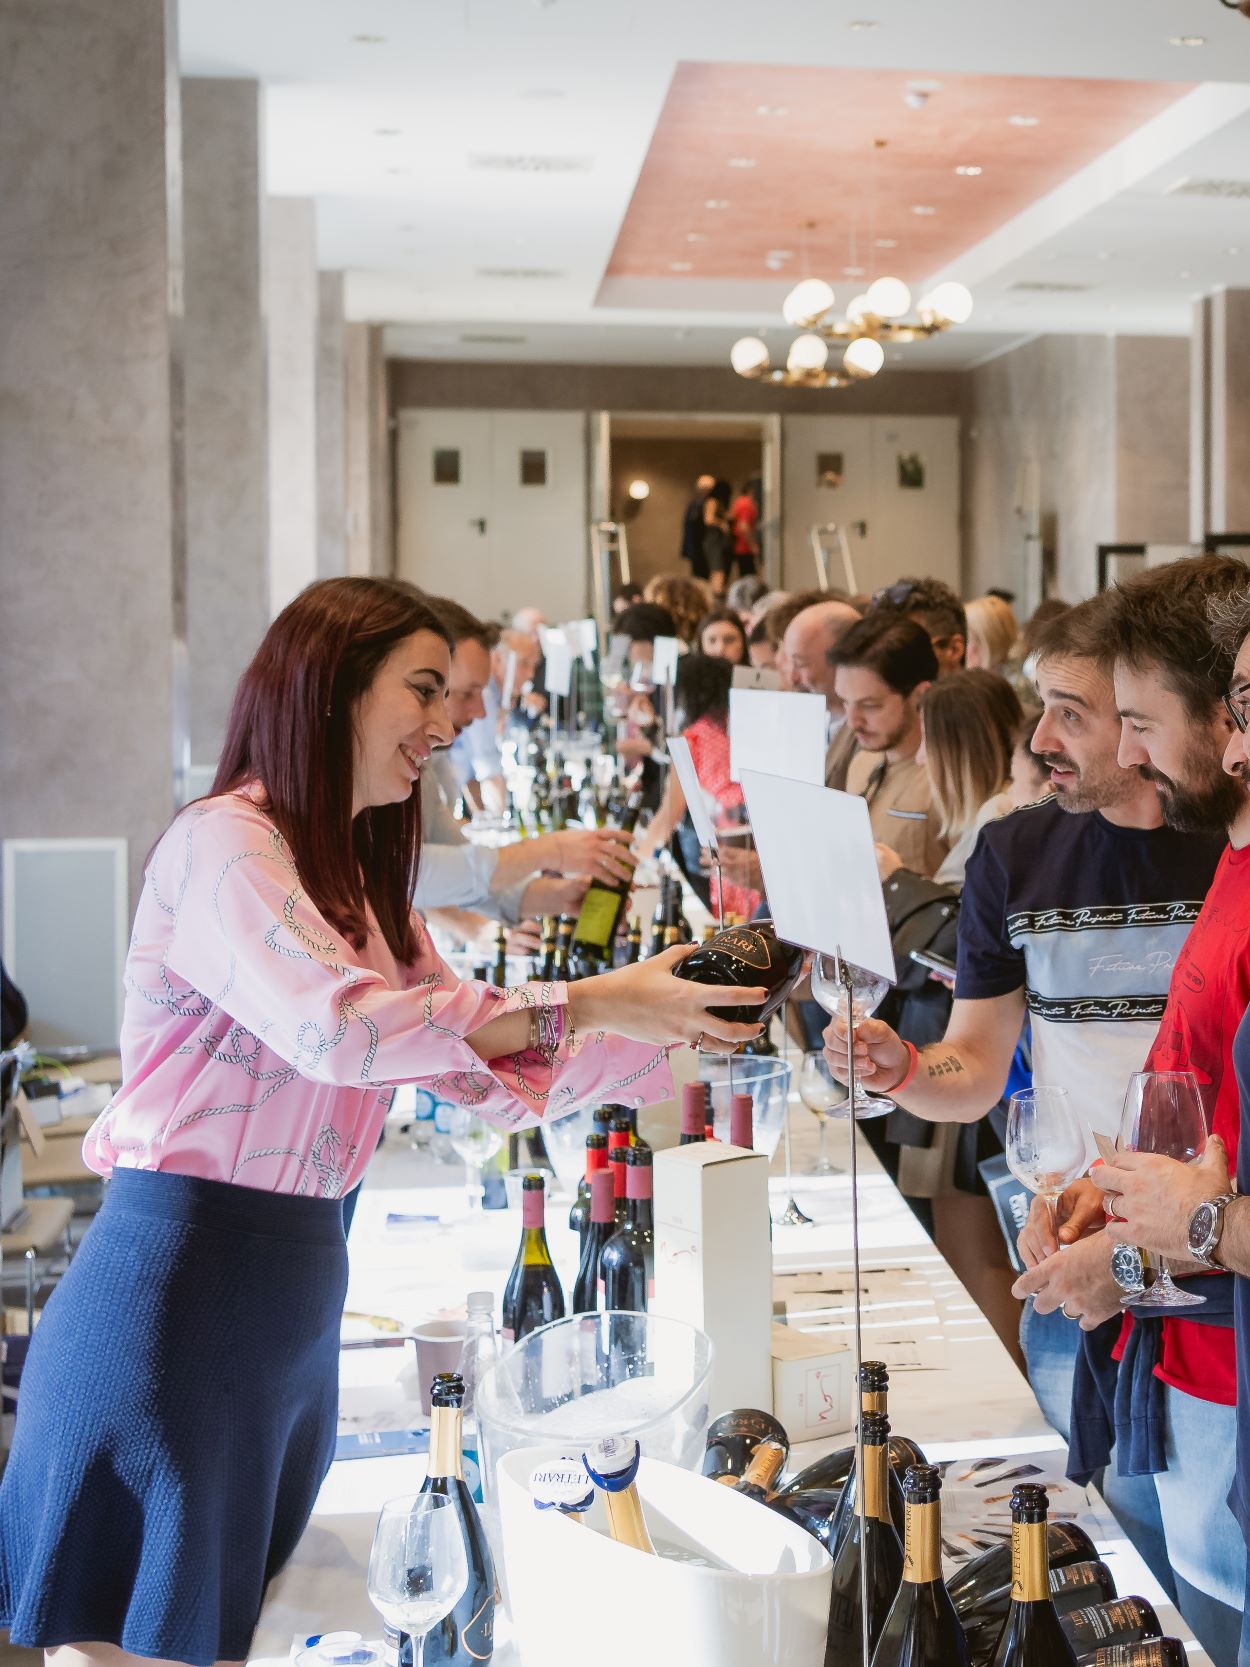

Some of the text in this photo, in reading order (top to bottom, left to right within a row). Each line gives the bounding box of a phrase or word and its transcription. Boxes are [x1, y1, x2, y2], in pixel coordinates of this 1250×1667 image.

[1034, 911, 1075, 930] Future
[1073, 909, 1123, 927] Project
[1127, 907, 1169, 924] Future
[1166, 903, 1200, 921] Proje
[1088, 954, 1146, 977] Future
[1070, 1001, 1111, 1019] Future
[1107, 1000, 1163, 1018] Project
[533, 1472, 589, 1485] LETRARI
[1013, 1525, 1021, 1577] LETRARI
